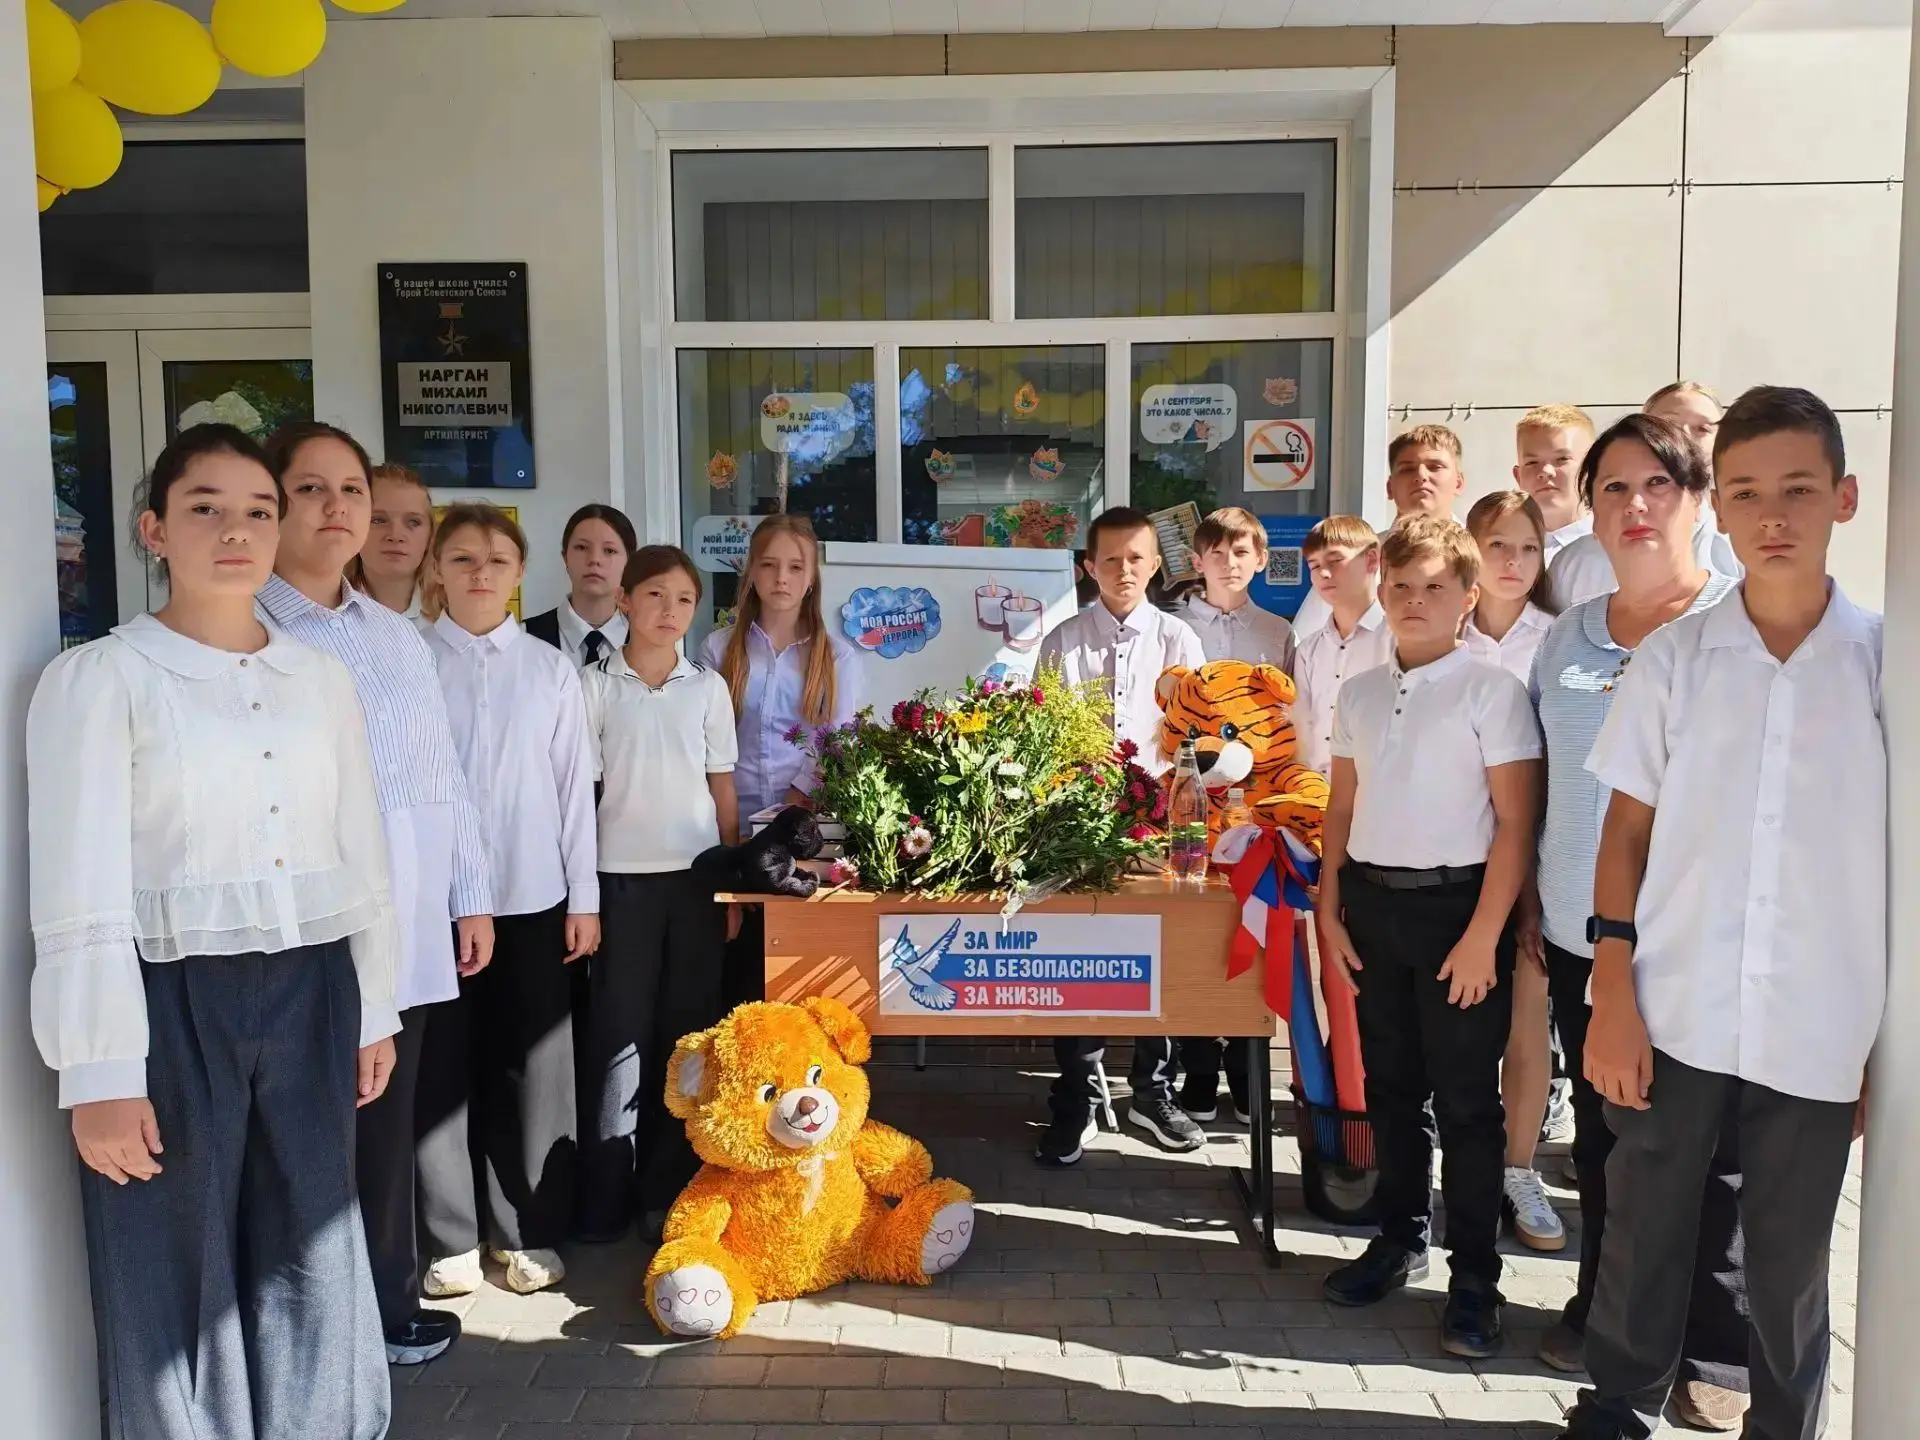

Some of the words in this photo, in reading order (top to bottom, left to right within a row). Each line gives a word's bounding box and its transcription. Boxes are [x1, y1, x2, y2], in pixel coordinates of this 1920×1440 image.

[394, 279, 400, 288] В
[404, 278, 434, 288] нашей
[438, 279, 470, 288] школе
[473, 279, 508, 289] учился
[396, 288, 421, 298] Герой
[423, 288, 474, 297] Советского
[476, 287, 507, 297] Союза
[419, 368, 489, 382] НАРГАН
[421, 386, 488, 399] МИХАИЛ
[1153, 397, 1160, 406] А
[1167, 396, 1212, 406] СЕНТЯБРЯ
[402, 403, 508, 415] НИКОЛАЕВИЧ
[1146, 407, 1162, 417] ЭТО
[1164, 407, 1192, 417] КАКОЕ
[788, 411, 795, 421] Я
[798, 411, 828, 421] ЗДЕСЬ
[776, 423, 799, 434] РАДИ
[424, 430, 489, 441] АРТИЛЛЕРИСТ
[703, 532, 722, 544] МОЙ
[724, 535, 746, 544] МОЗГ
[700, 546, 707, 555] К
[860, 614, 883, 629] МОЯ
[885, 610, 928, 627] РОССИЯ
[882, 628, 919, 644] ТЕРРОРА
[964, 930, 989, 950] ЗА
[995, 930, 1038, 950] МИР
[963, 958, 989, 978] ЗА
[995, 958, 1143, 979] БЕЗОПАСНОСТЬ
[963, 985, 989, 1006] ЗА
[995, 985, 1064, 1006] ЖИЗНЬ
